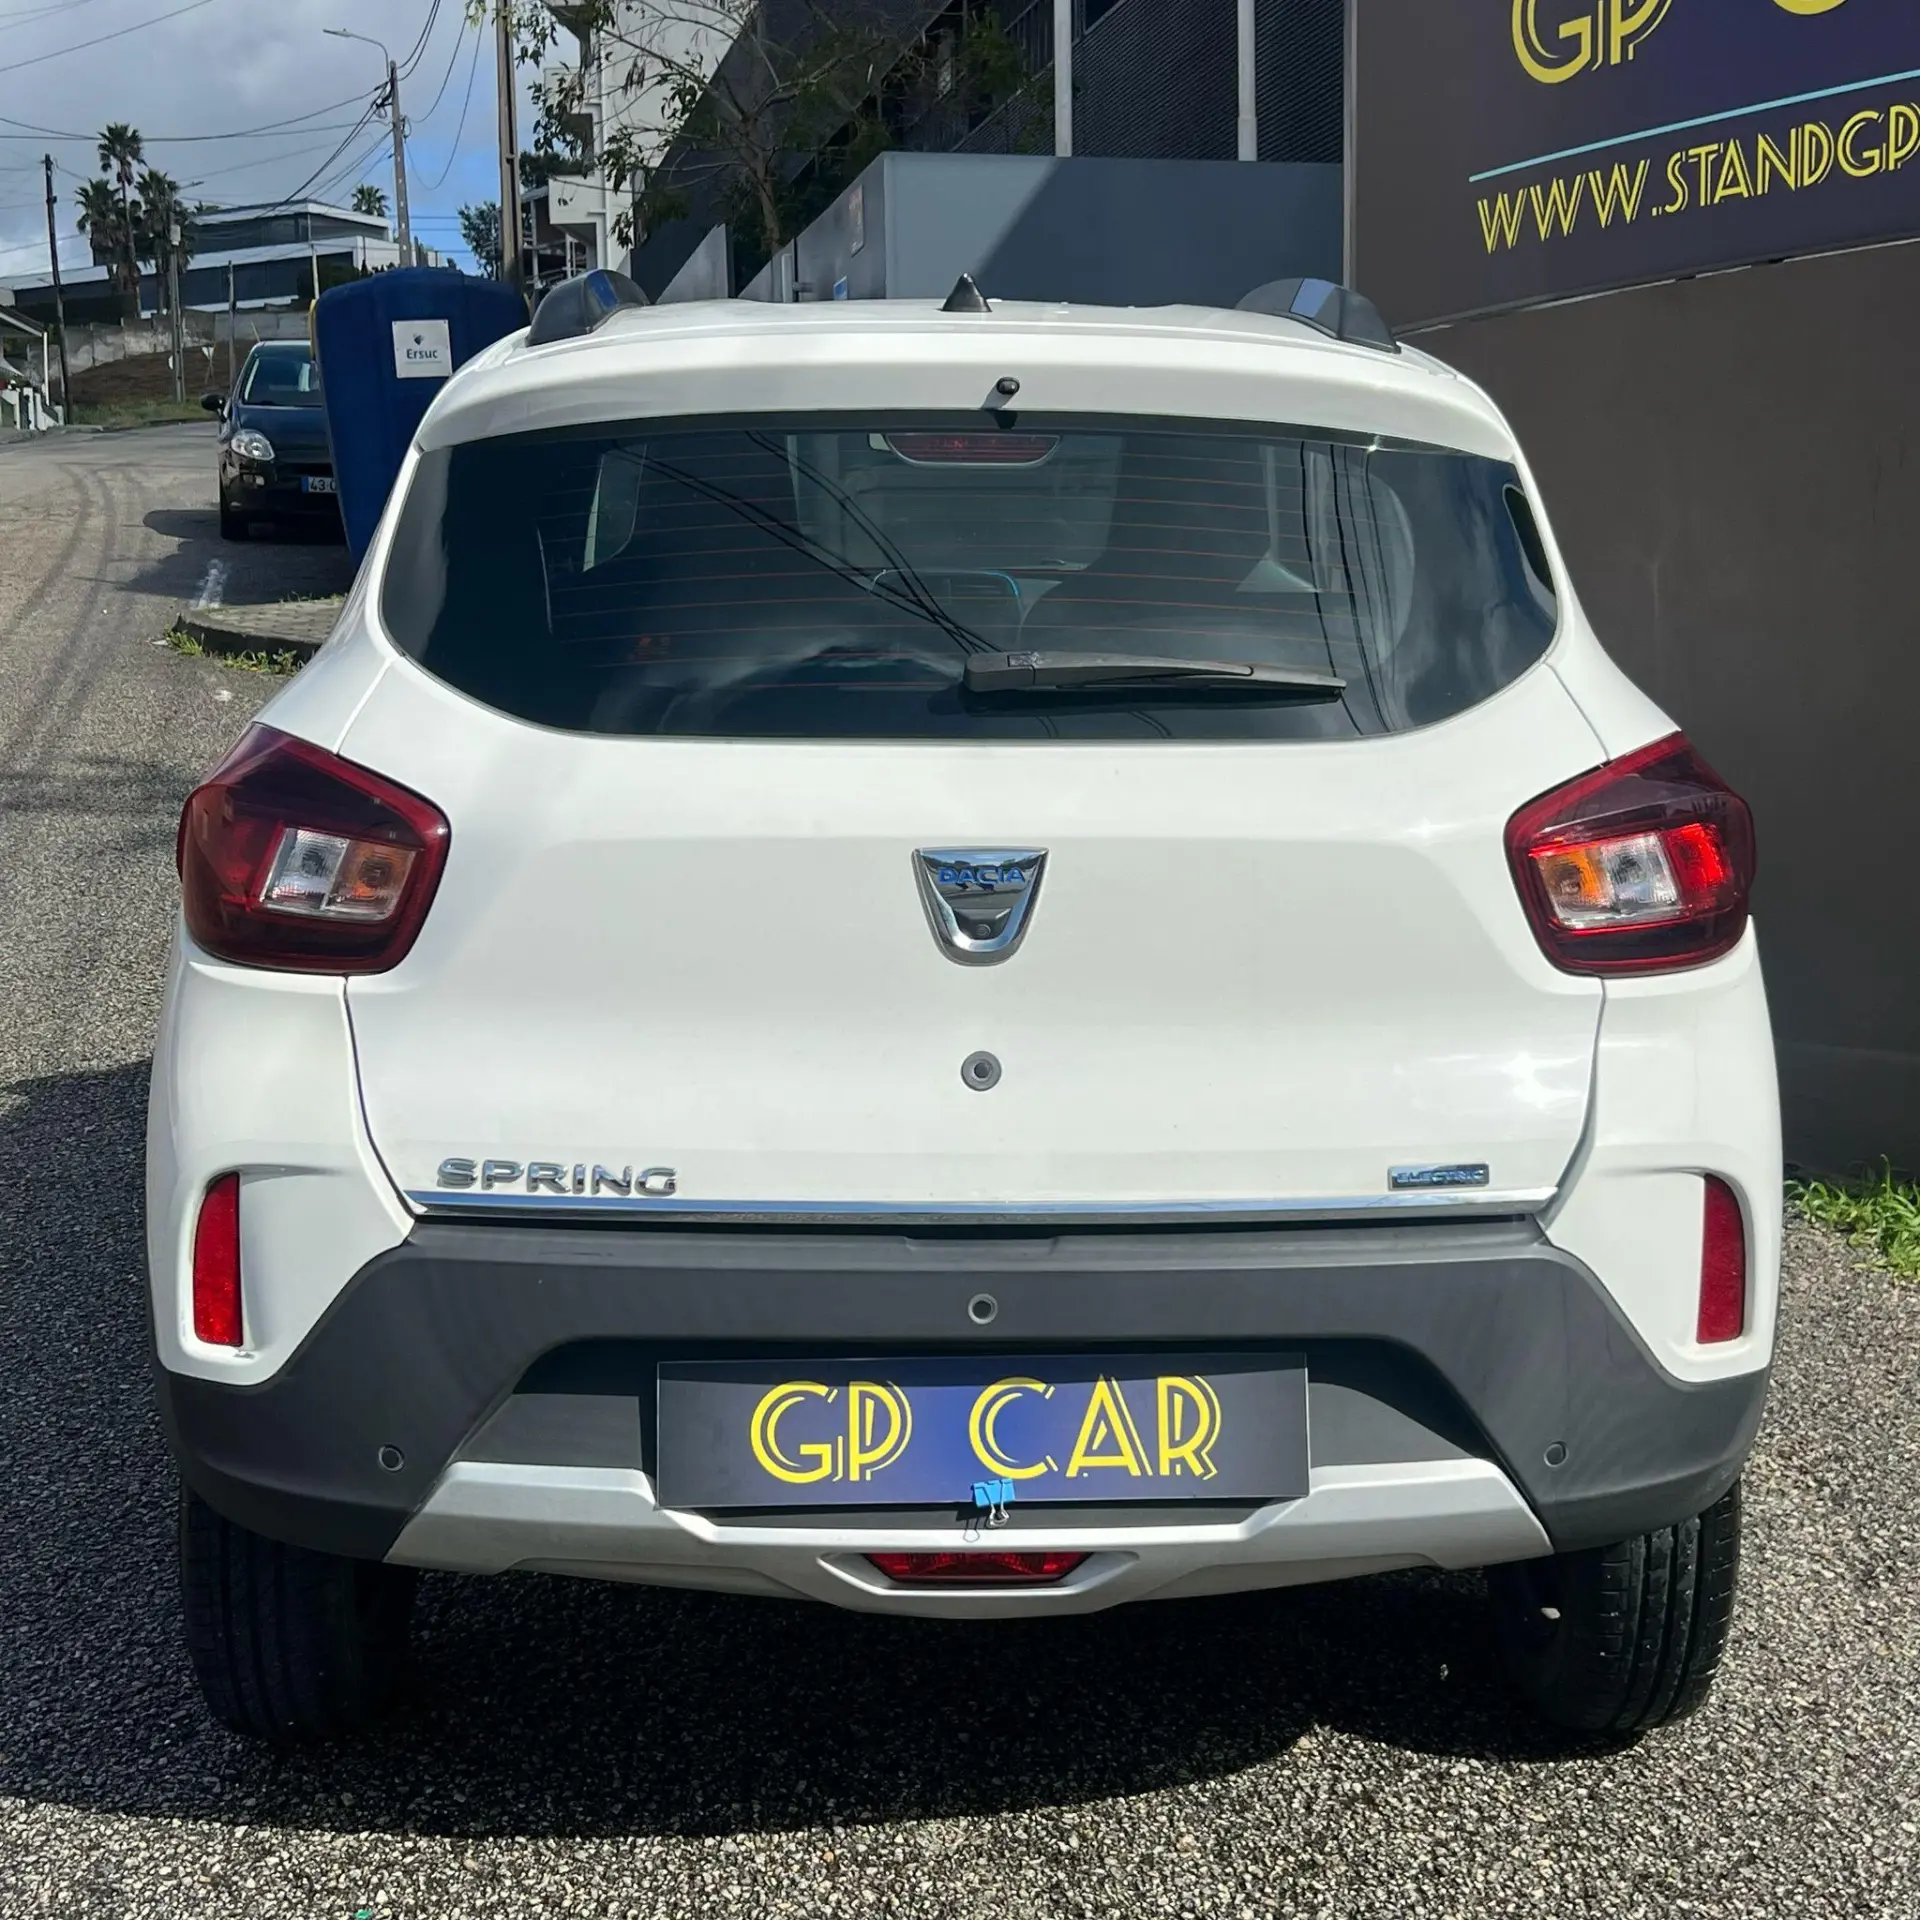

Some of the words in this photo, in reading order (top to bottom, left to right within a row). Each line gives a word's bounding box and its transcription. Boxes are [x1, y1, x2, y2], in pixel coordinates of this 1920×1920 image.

[406, 348, 438, 359] Ersuc
[937, 866, 1026, 885] DACIA
[437, 1157, 676, 1197] SPRING
[750, 1379, 912, 1483] GP
[969, 1375, 1221, 1480] CAR
